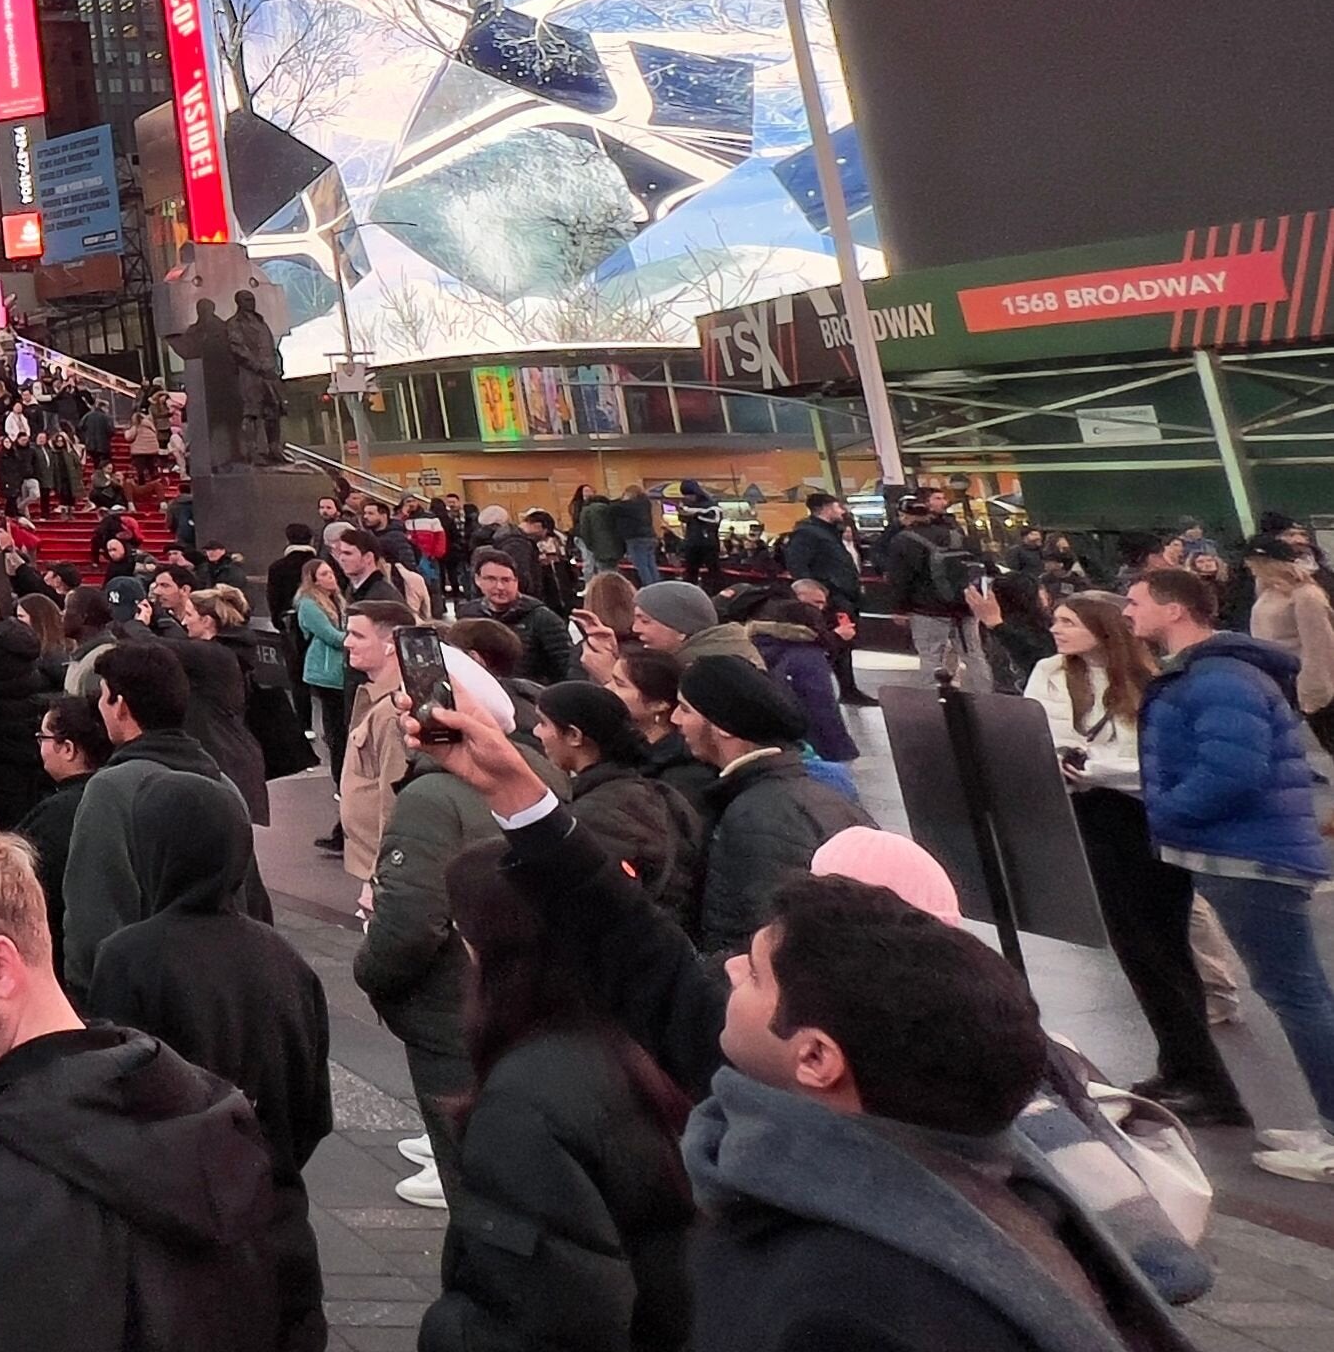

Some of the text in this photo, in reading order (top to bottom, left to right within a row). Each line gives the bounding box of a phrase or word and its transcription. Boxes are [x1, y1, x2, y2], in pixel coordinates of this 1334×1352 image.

[1002, 270, 1228, 317] 1568 BROADWAY
[714, 301, 793, 390] TSX
[819, 302, 936, 350] BRODWAY
